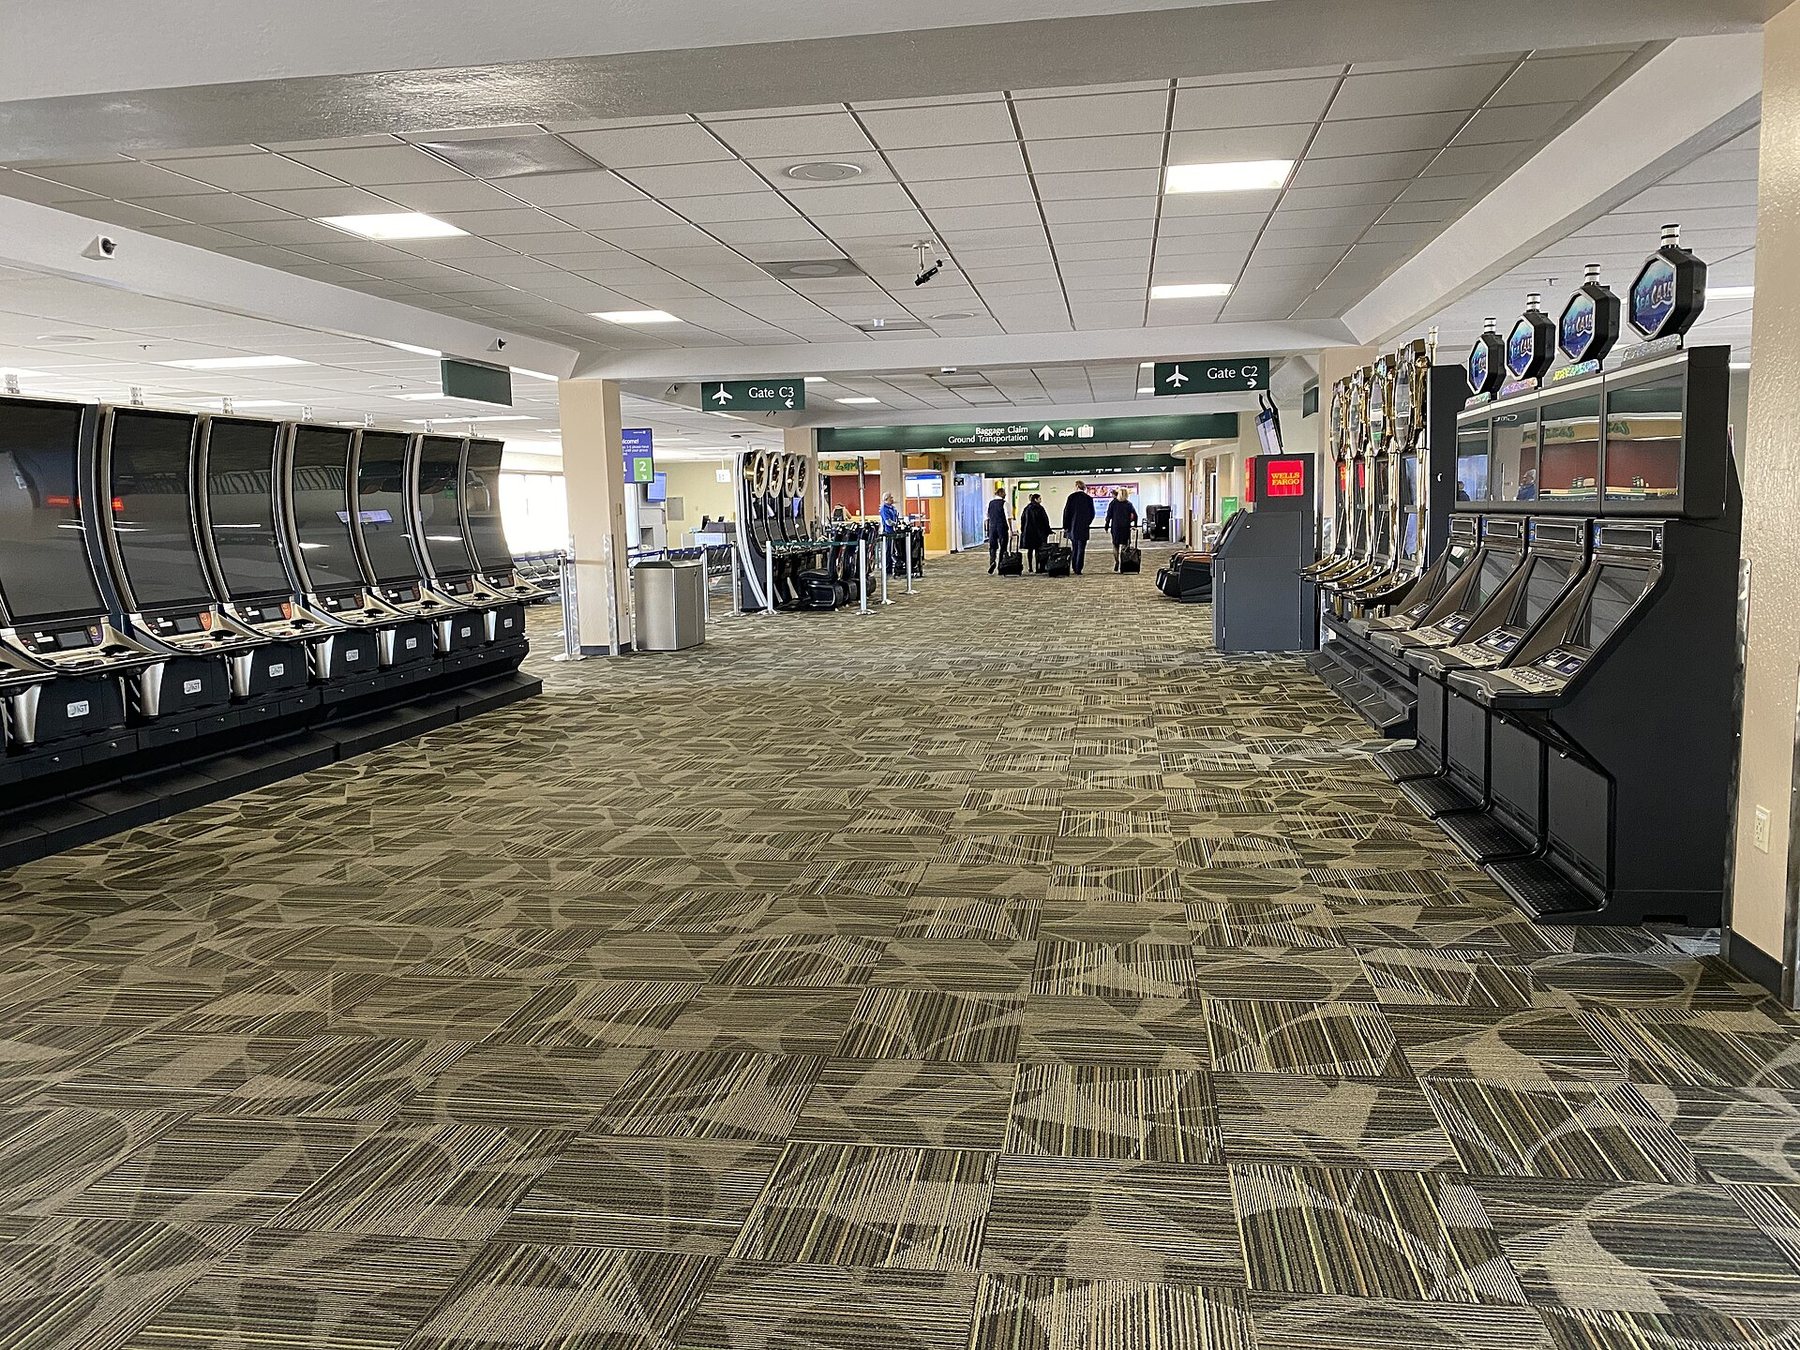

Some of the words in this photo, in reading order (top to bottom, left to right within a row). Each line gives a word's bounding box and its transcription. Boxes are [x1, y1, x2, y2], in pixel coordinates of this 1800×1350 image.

[1207, 367, 1236, 379] Gate
[1241, 365, 1258, 378] C2
[748, 386, 775, 398] Gate
[779, 386, 794, 398] C3
[975, 427, 1005, 436] Baggage
[1007, 425, 1028, 433] Claim
[948, 435, 975, 443] Ground
[978, 434, 1028, 444] Transportation
[639, 461, 647, 471] 2
[1272, 478, 1300, 486] FARGO
